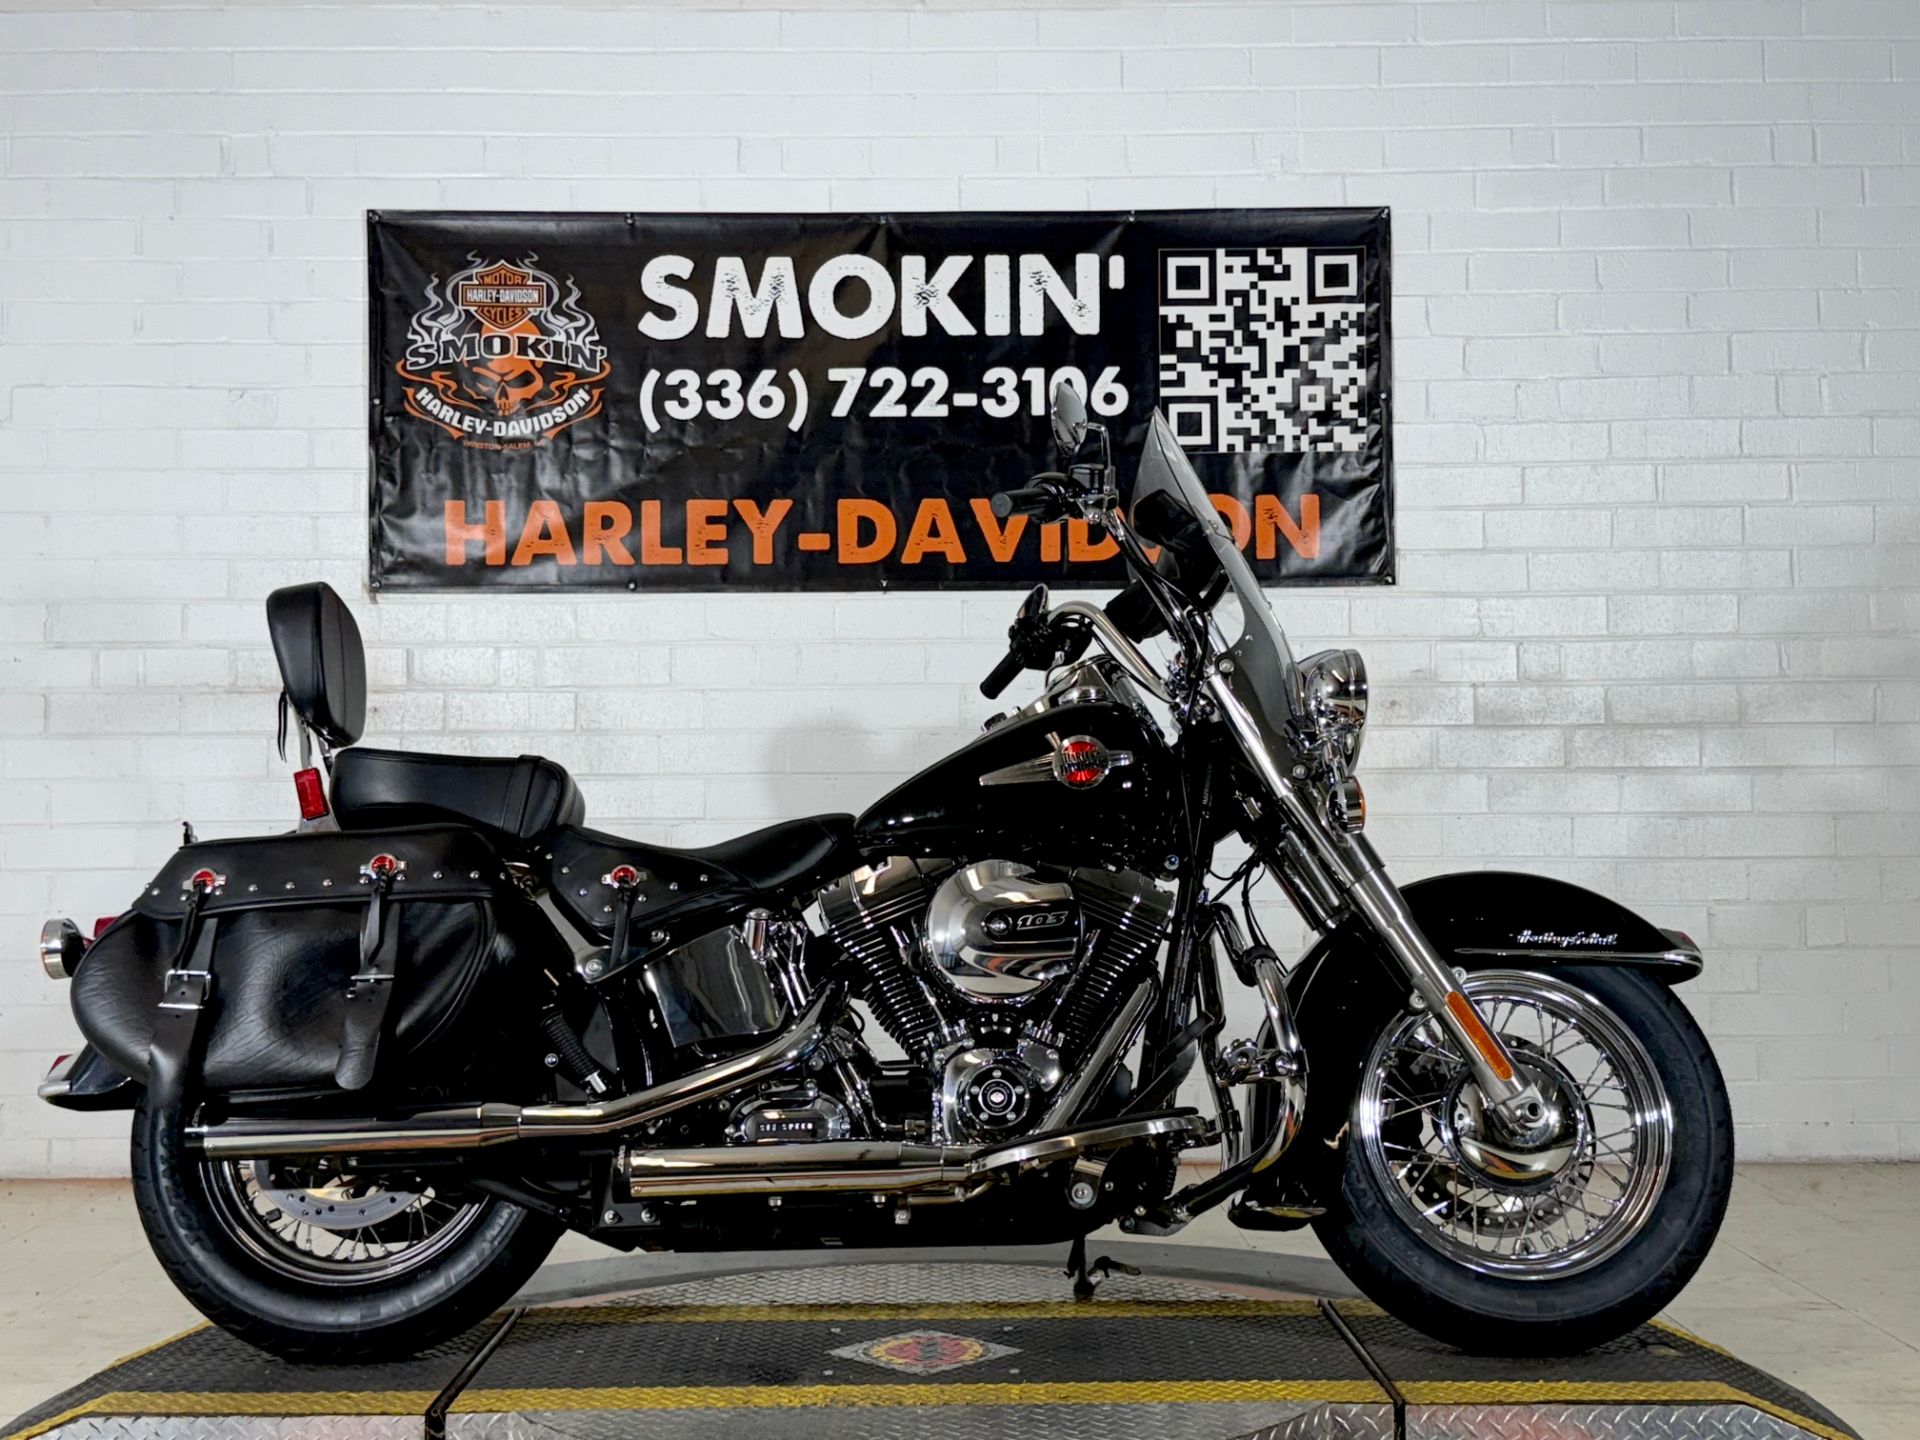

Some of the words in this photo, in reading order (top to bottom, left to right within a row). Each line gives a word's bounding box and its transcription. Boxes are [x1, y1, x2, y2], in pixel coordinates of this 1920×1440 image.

[466, 288, 539, 303] HARLEY-DAVIDSON
[483, 272, 524, 285] MOTOR
[638, 253, 1125, 340] SMOKIN'
[483, 307, 524, 323] CYCLES
[406, 333, 608, 373] SMOKIN'
[415, 386, 592, 437] HARLEY-DAVIDSON
[639, 368, 809, 433] (336)
[828, 366, 1129, 420] 722-3106
[444, 494, 1320, 566] HARLEY-DAVIDON
[1017, 911, 1069, 930] 103
